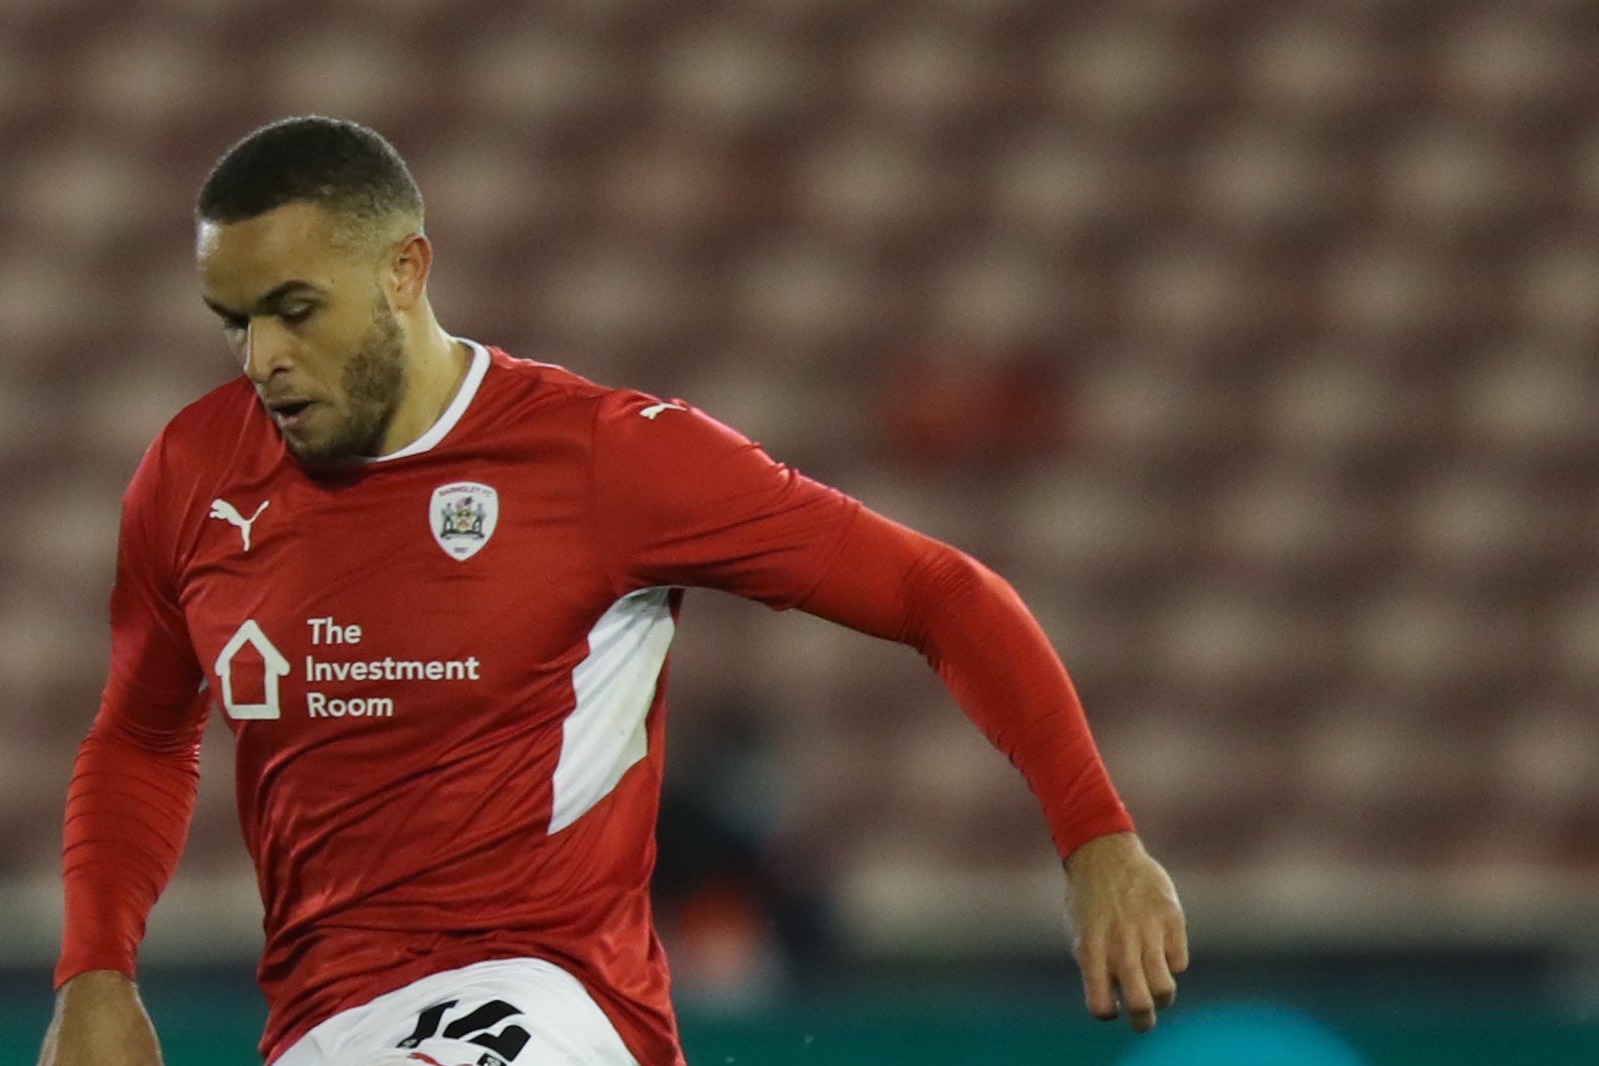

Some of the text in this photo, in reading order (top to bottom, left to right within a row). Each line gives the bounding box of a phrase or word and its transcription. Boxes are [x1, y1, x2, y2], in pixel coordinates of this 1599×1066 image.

[306, 617, 362, 645] The
[305, 656, 480, 682] Investment
[306, 692, 394, 718] Room
[396, 999, 532, 1063] 14
